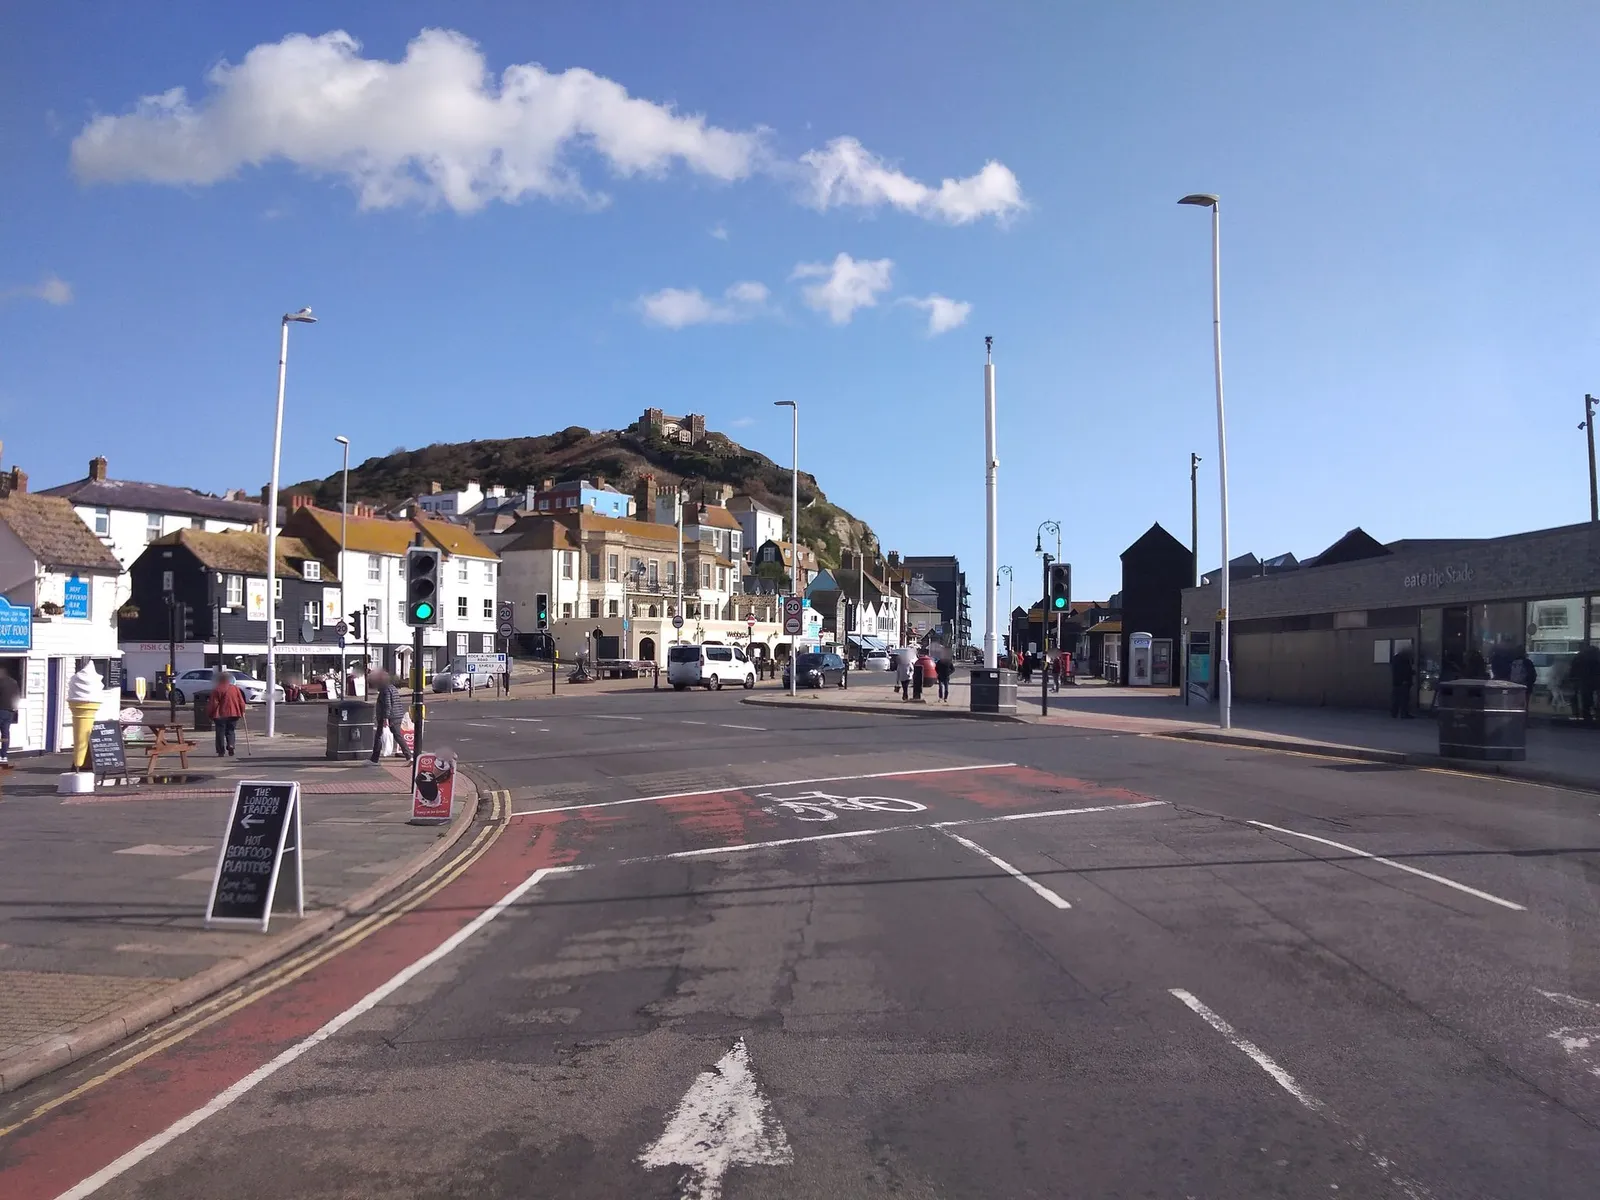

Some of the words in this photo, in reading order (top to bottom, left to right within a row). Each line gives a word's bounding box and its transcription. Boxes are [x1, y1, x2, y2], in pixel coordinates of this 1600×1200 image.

[1446, 562, 1473, 583] Stade
[787, 603, 799, 611] 20
[254, 787, 271, 797] THE
[245, 796, 280, 806] LONDON
[243, 805, 279, 815] TRADER
[244, 834, 265, 845] HOT
[226, 846, 273, 859] SEAFOOD
[223, 860, 272, 875] PLATTERS
